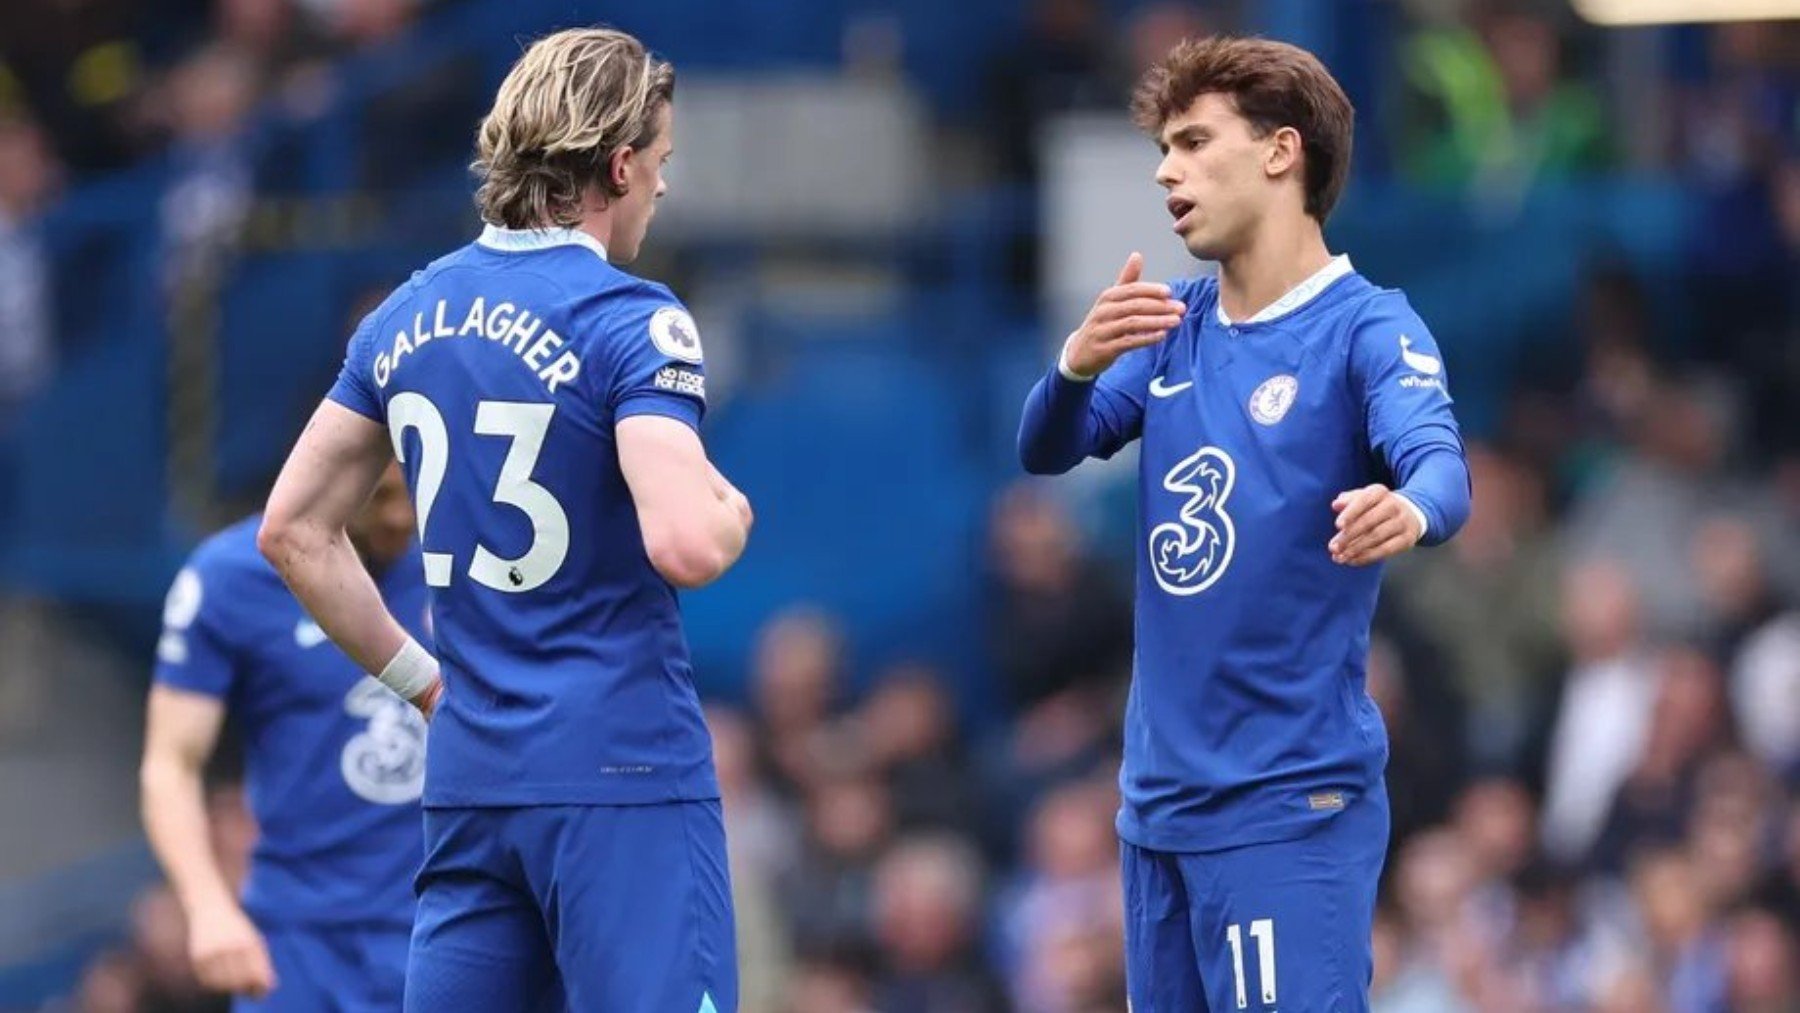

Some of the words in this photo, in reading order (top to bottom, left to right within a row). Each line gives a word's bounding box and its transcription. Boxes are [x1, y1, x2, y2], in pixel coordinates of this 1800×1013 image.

[373, 296, 580, 394] GALLAGHER
[388, 391, 569, 592] 23
[1150, 446, 1235, 596] 3
[1226, 918, 1277, 1009] 11
